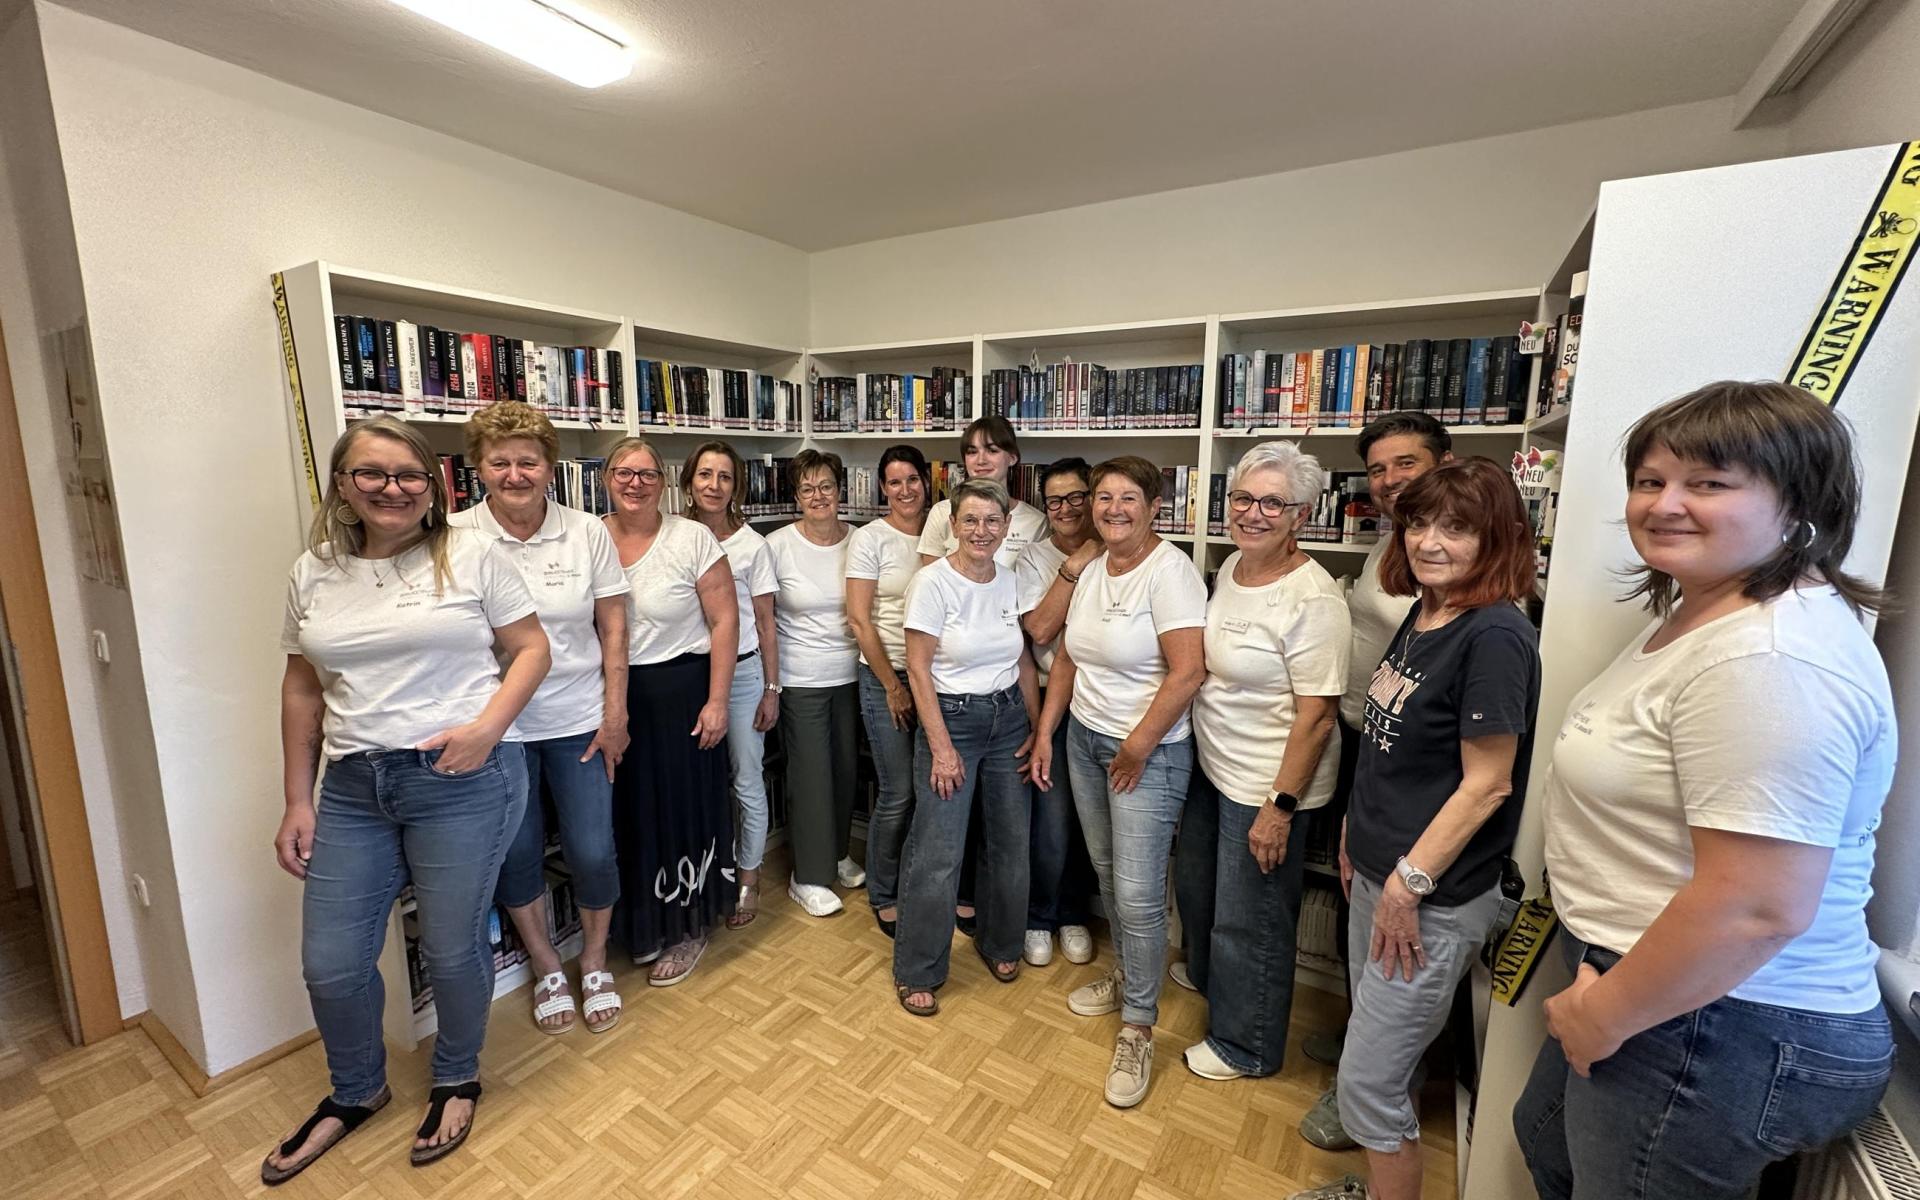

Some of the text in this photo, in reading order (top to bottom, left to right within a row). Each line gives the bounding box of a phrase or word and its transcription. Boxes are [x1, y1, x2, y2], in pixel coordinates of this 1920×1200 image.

[274, 285, 295, 369] WARNING
[1799, 248, 1900, 391] WARNING
[385, 326, 395, 367] ERWARTUNG
[428, 332, 436, 357] SELFIES
[1521, 340, 1536, 351] NEU
[1294, 361, 1307, 405] MARC RAABE
[1525, 469, 1544, 483] NEU
[1492, 899, 1553, 994] WARNING
